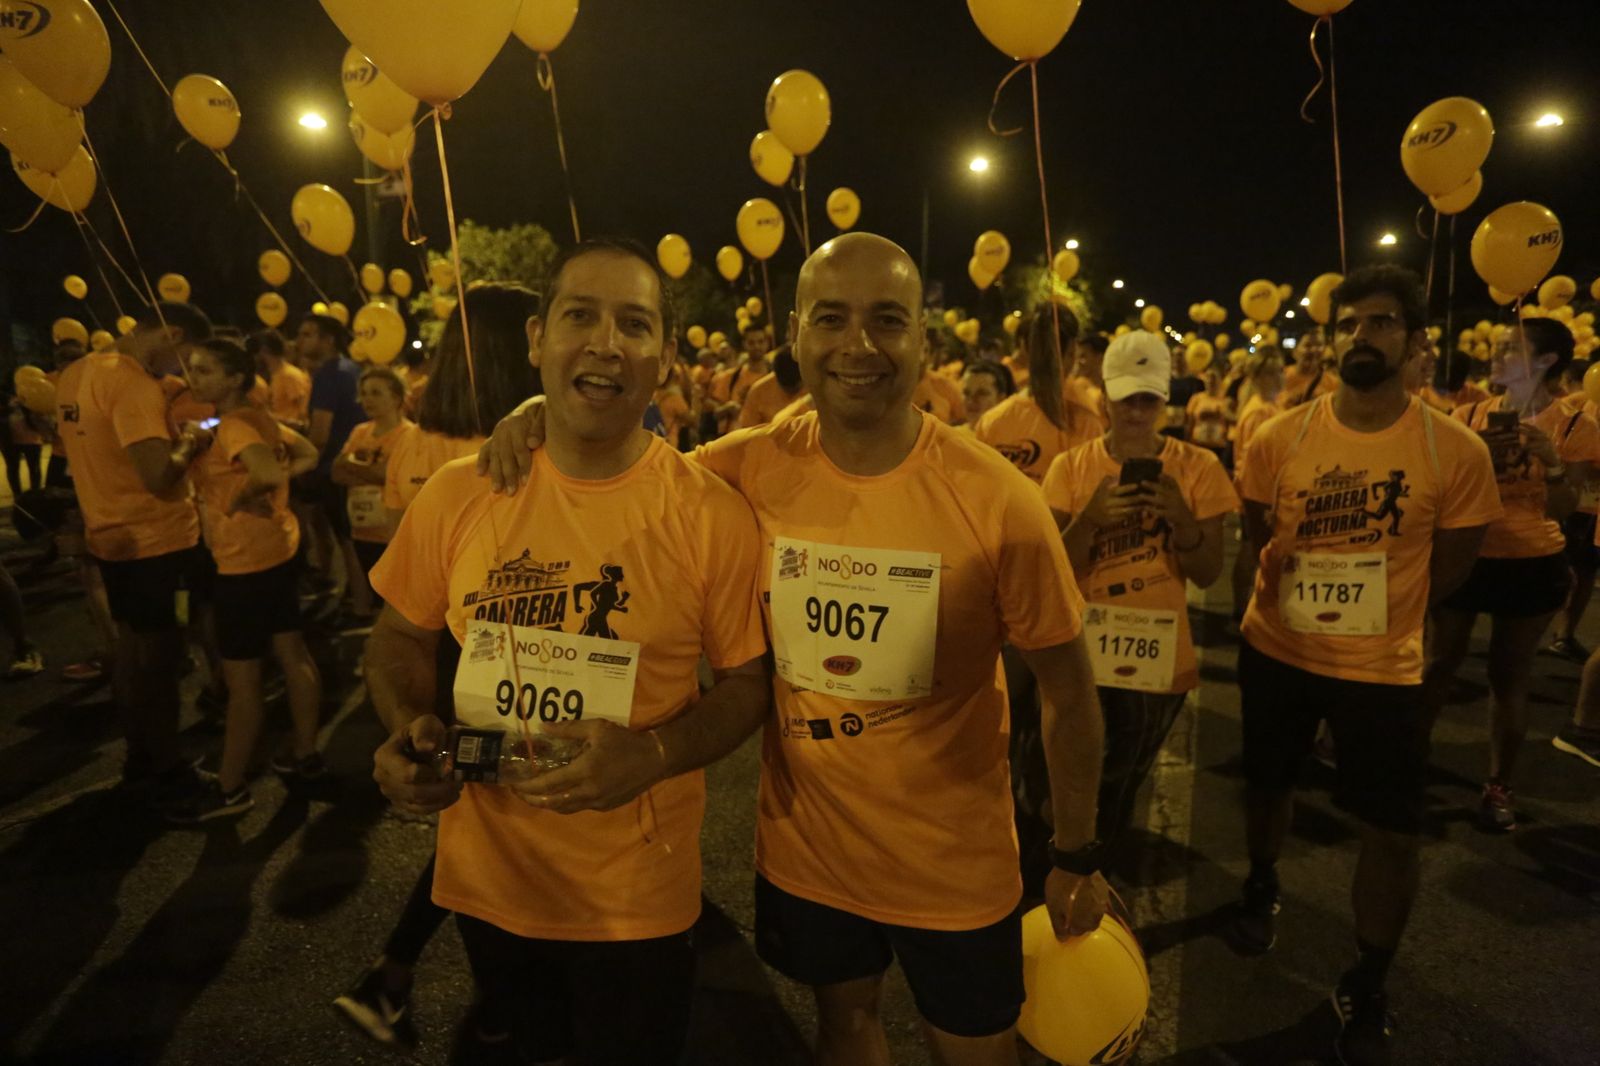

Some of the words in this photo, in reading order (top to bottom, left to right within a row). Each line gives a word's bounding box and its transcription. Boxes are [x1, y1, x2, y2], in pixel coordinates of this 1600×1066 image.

[1408, 127, 1446, 147] KH7
[1527, 230, 1559, 248] KH7
[1304, 487, 1368, 515] CARRERA
[1295, 508, 1367, 538] NOCTURNA
[1295, 581, 1365, 604] 11787
[474, 590, 568, 628] CARRERA
[805, 596, 890, 643] 9067
[1098, 634, 1160, 660] 11786
[495, 679, 584, 723] 9069
